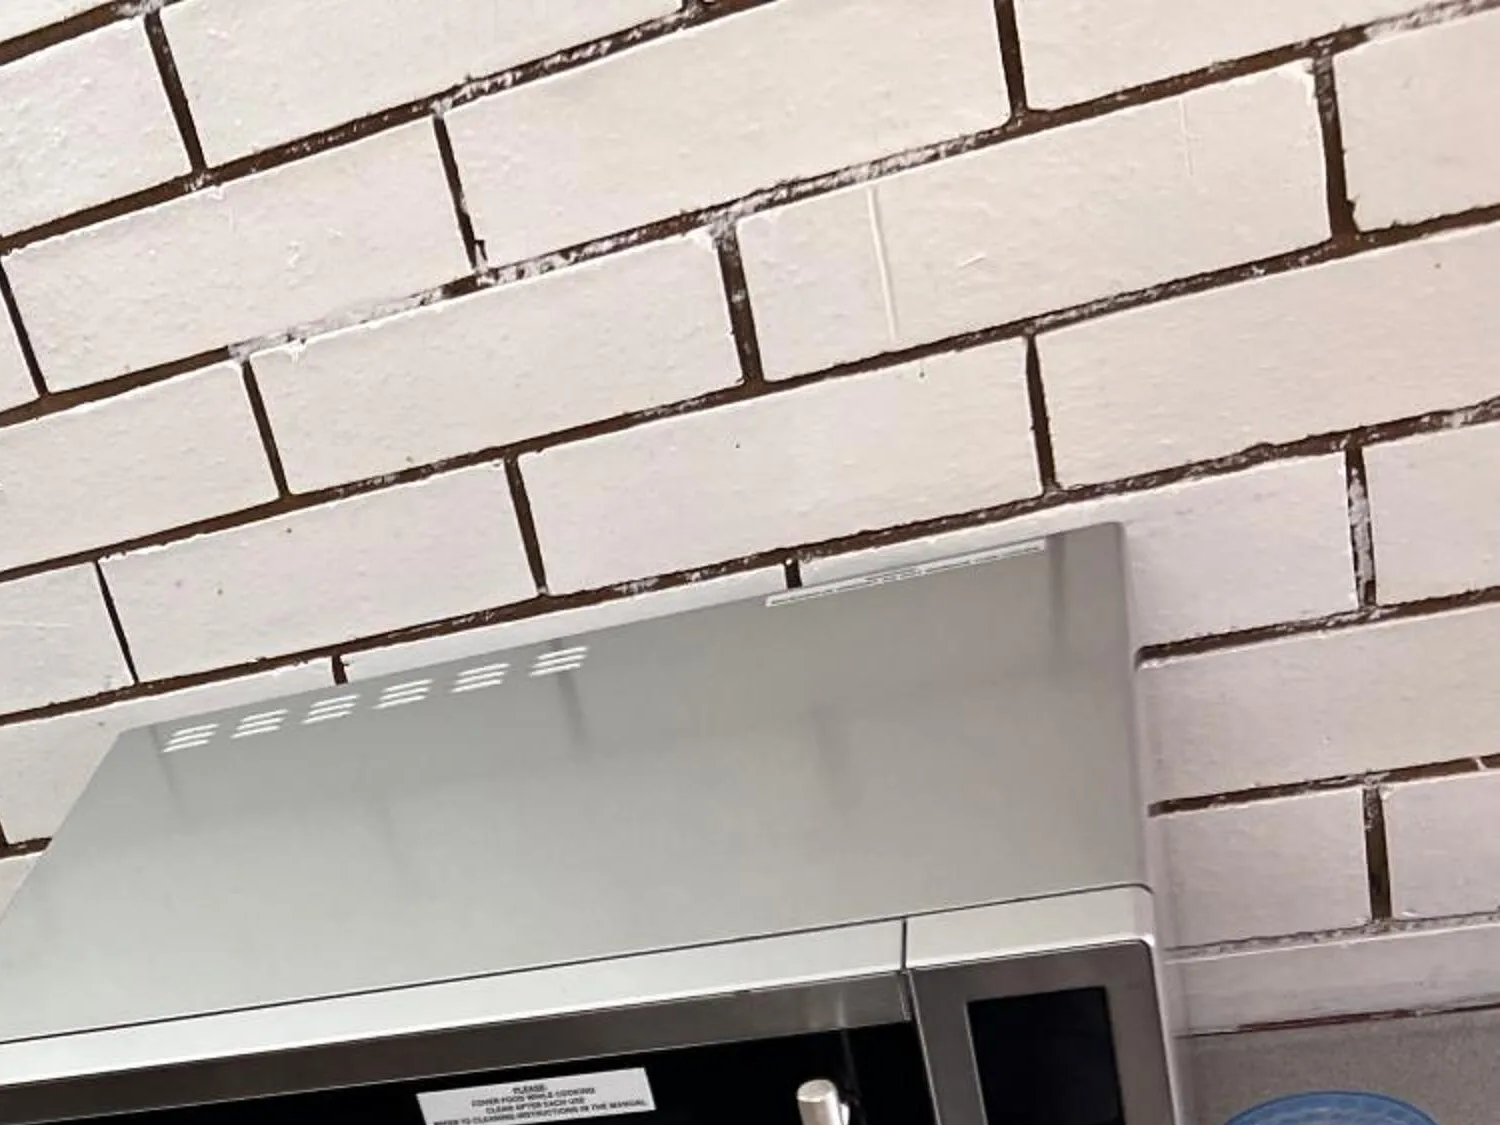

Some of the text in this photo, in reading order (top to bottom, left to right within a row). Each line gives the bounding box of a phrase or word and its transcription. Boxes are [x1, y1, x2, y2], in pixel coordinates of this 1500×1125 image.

[501, 1094, 525, 1104] FOOD
[527, 1091, 553, 1101] WHILE
[555, 1087, 596, 1098] COOKING
[473, 1113, 515, 1124] CLEANING
[515, 1106, 579, 1119] INSTRUCTIONS
[609, 1099, 647, 1109] MANUAL
[515, 1101, 542, 1111] AFTER
